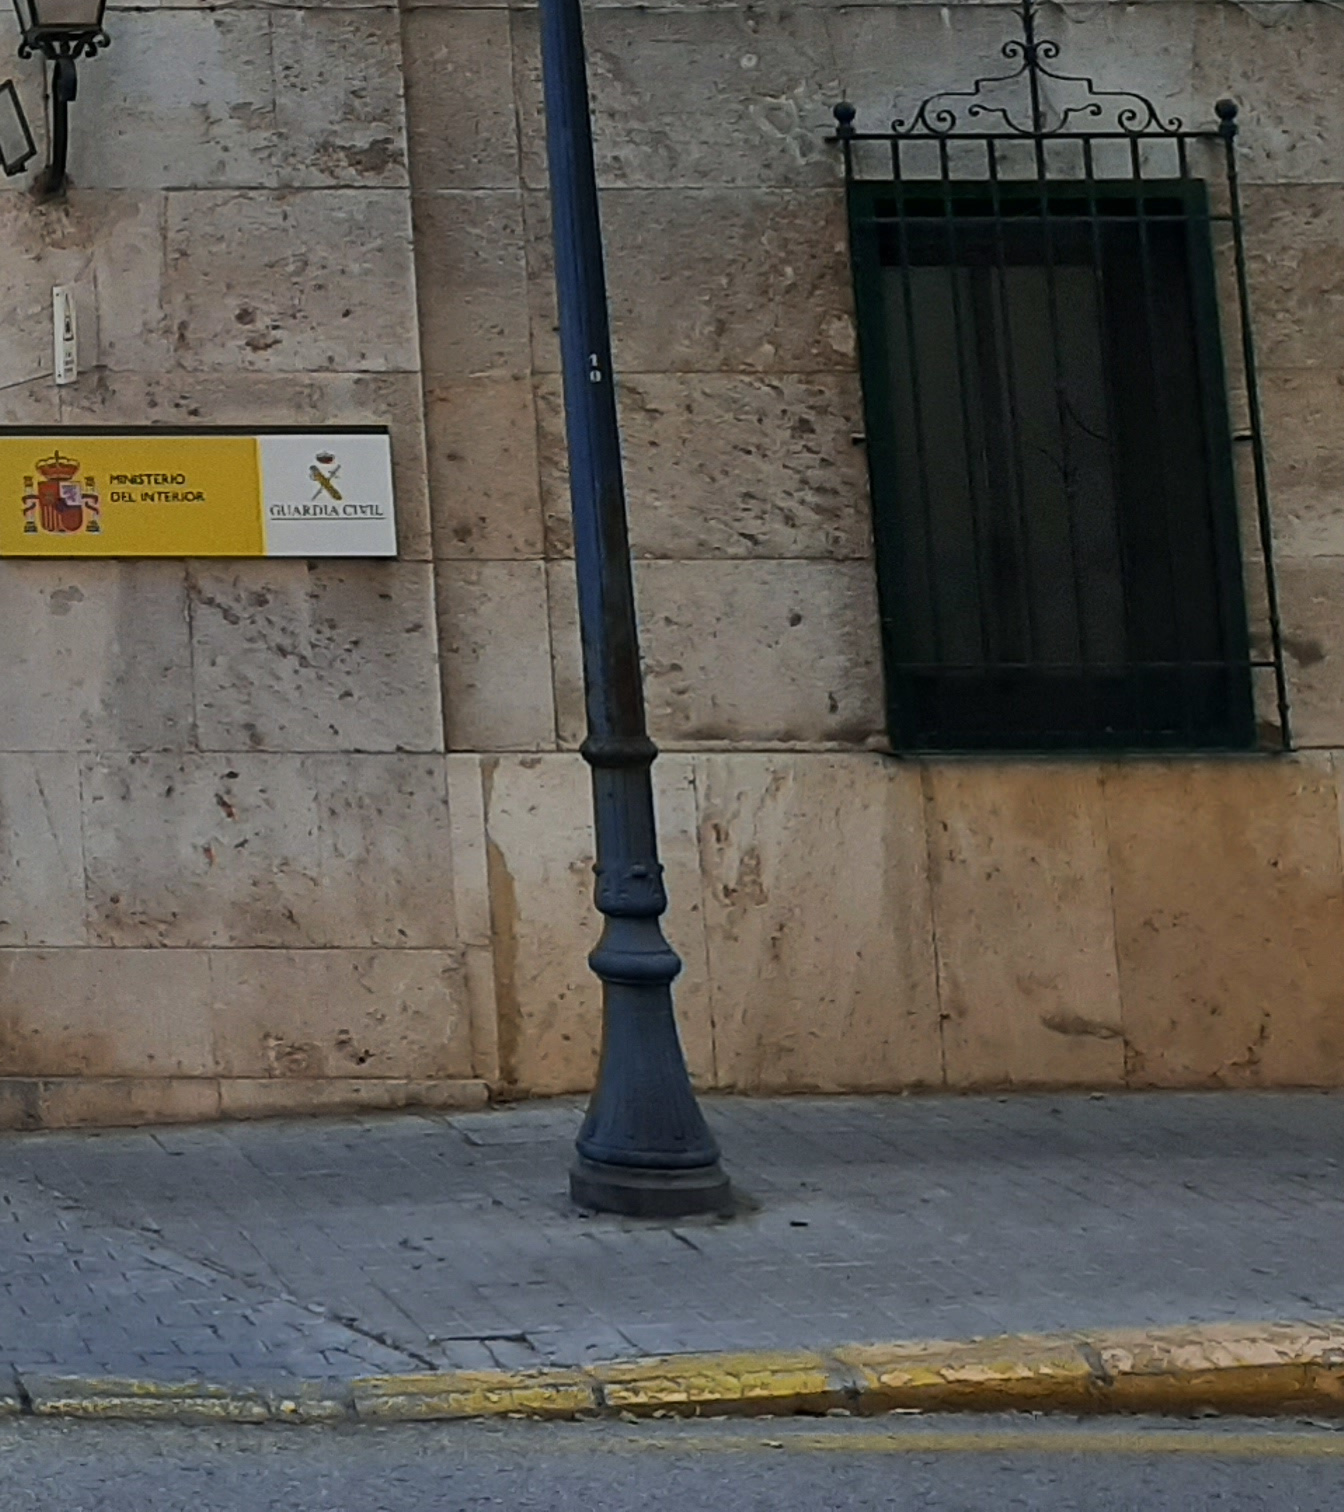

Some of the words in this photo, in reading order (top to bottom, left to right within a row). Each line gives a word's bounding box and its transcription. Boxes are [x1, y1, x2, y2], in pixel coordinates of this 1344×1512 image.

[110, 473, 186, 485] MINISTERIO
[110, 491, 137, 503] DEL
[140, 491, 206, 503] INTERIOR
[269, 504, 339, 517] GUARDIA
[342, 504, 384, 517] CIVIL
